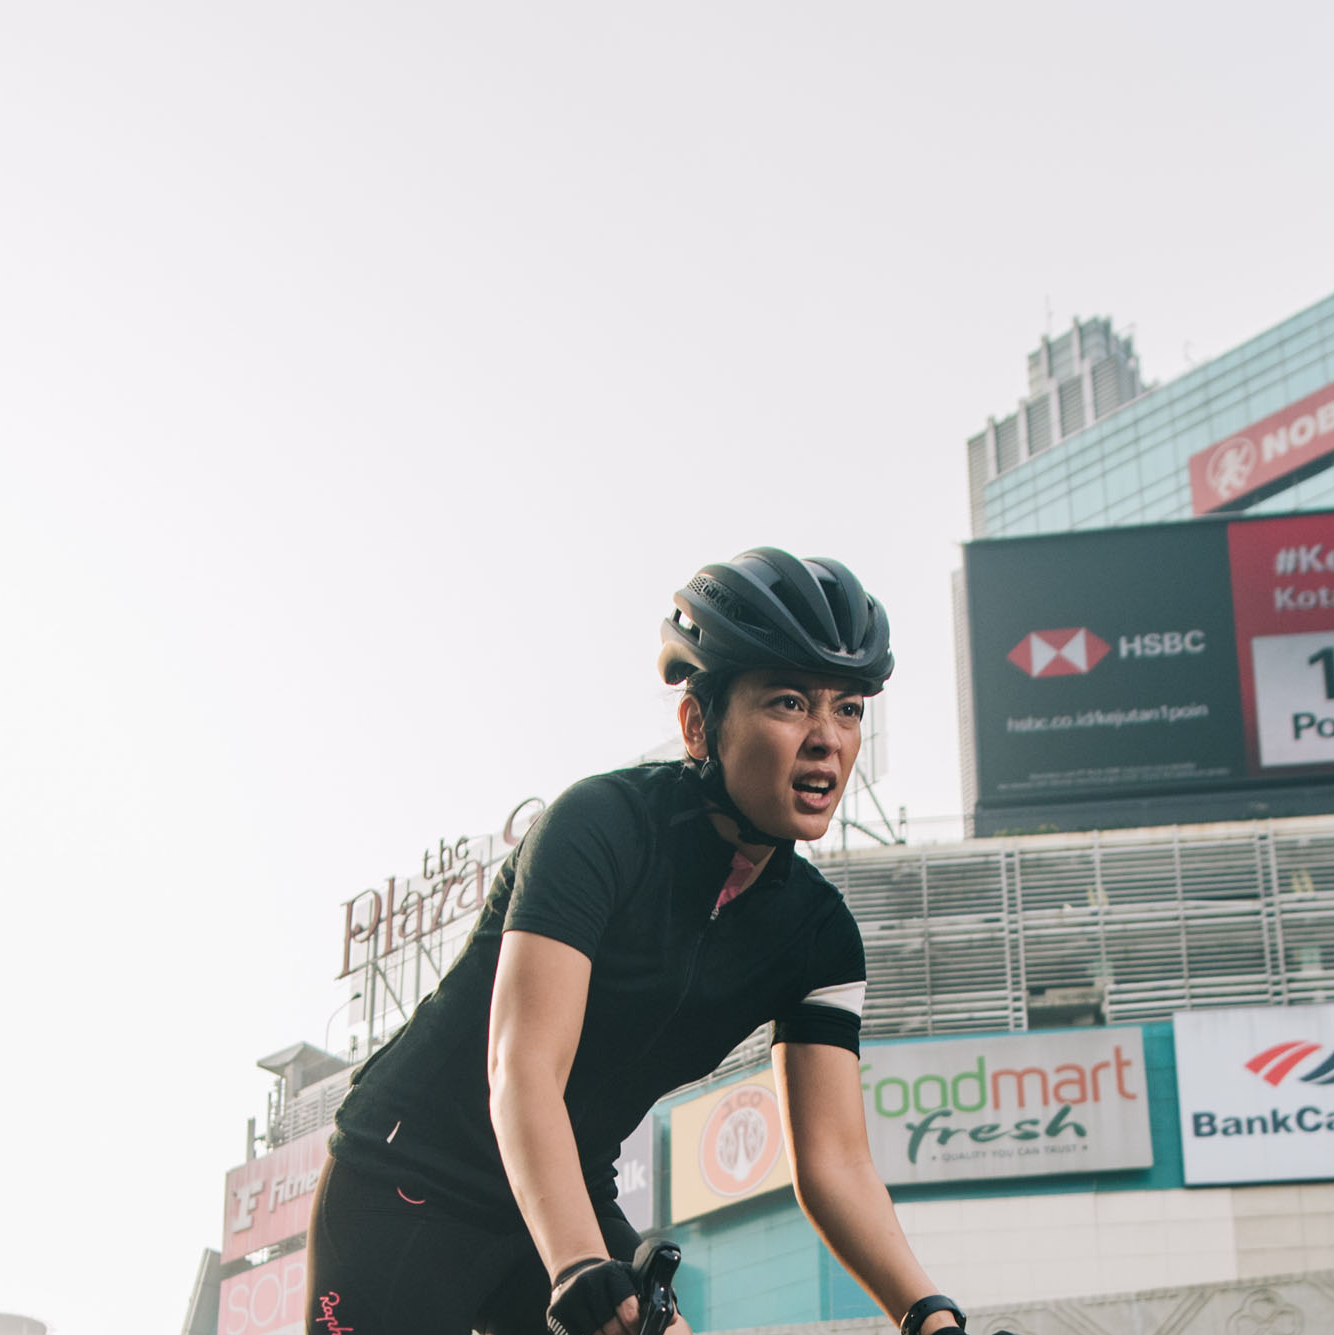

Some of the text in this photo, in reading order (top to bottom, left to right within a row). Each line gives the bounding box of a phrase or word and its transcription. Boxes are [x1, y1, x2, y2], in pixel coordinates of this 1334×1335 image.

[1119, 629, 1207, 660] HSBC
[421, 836, 470, 881] the
[906, 1106, 1088, 1164] fresh
[942, 1151, 987, 1163] QUALITY
[992, 1149, 1013, 1159] YOU
